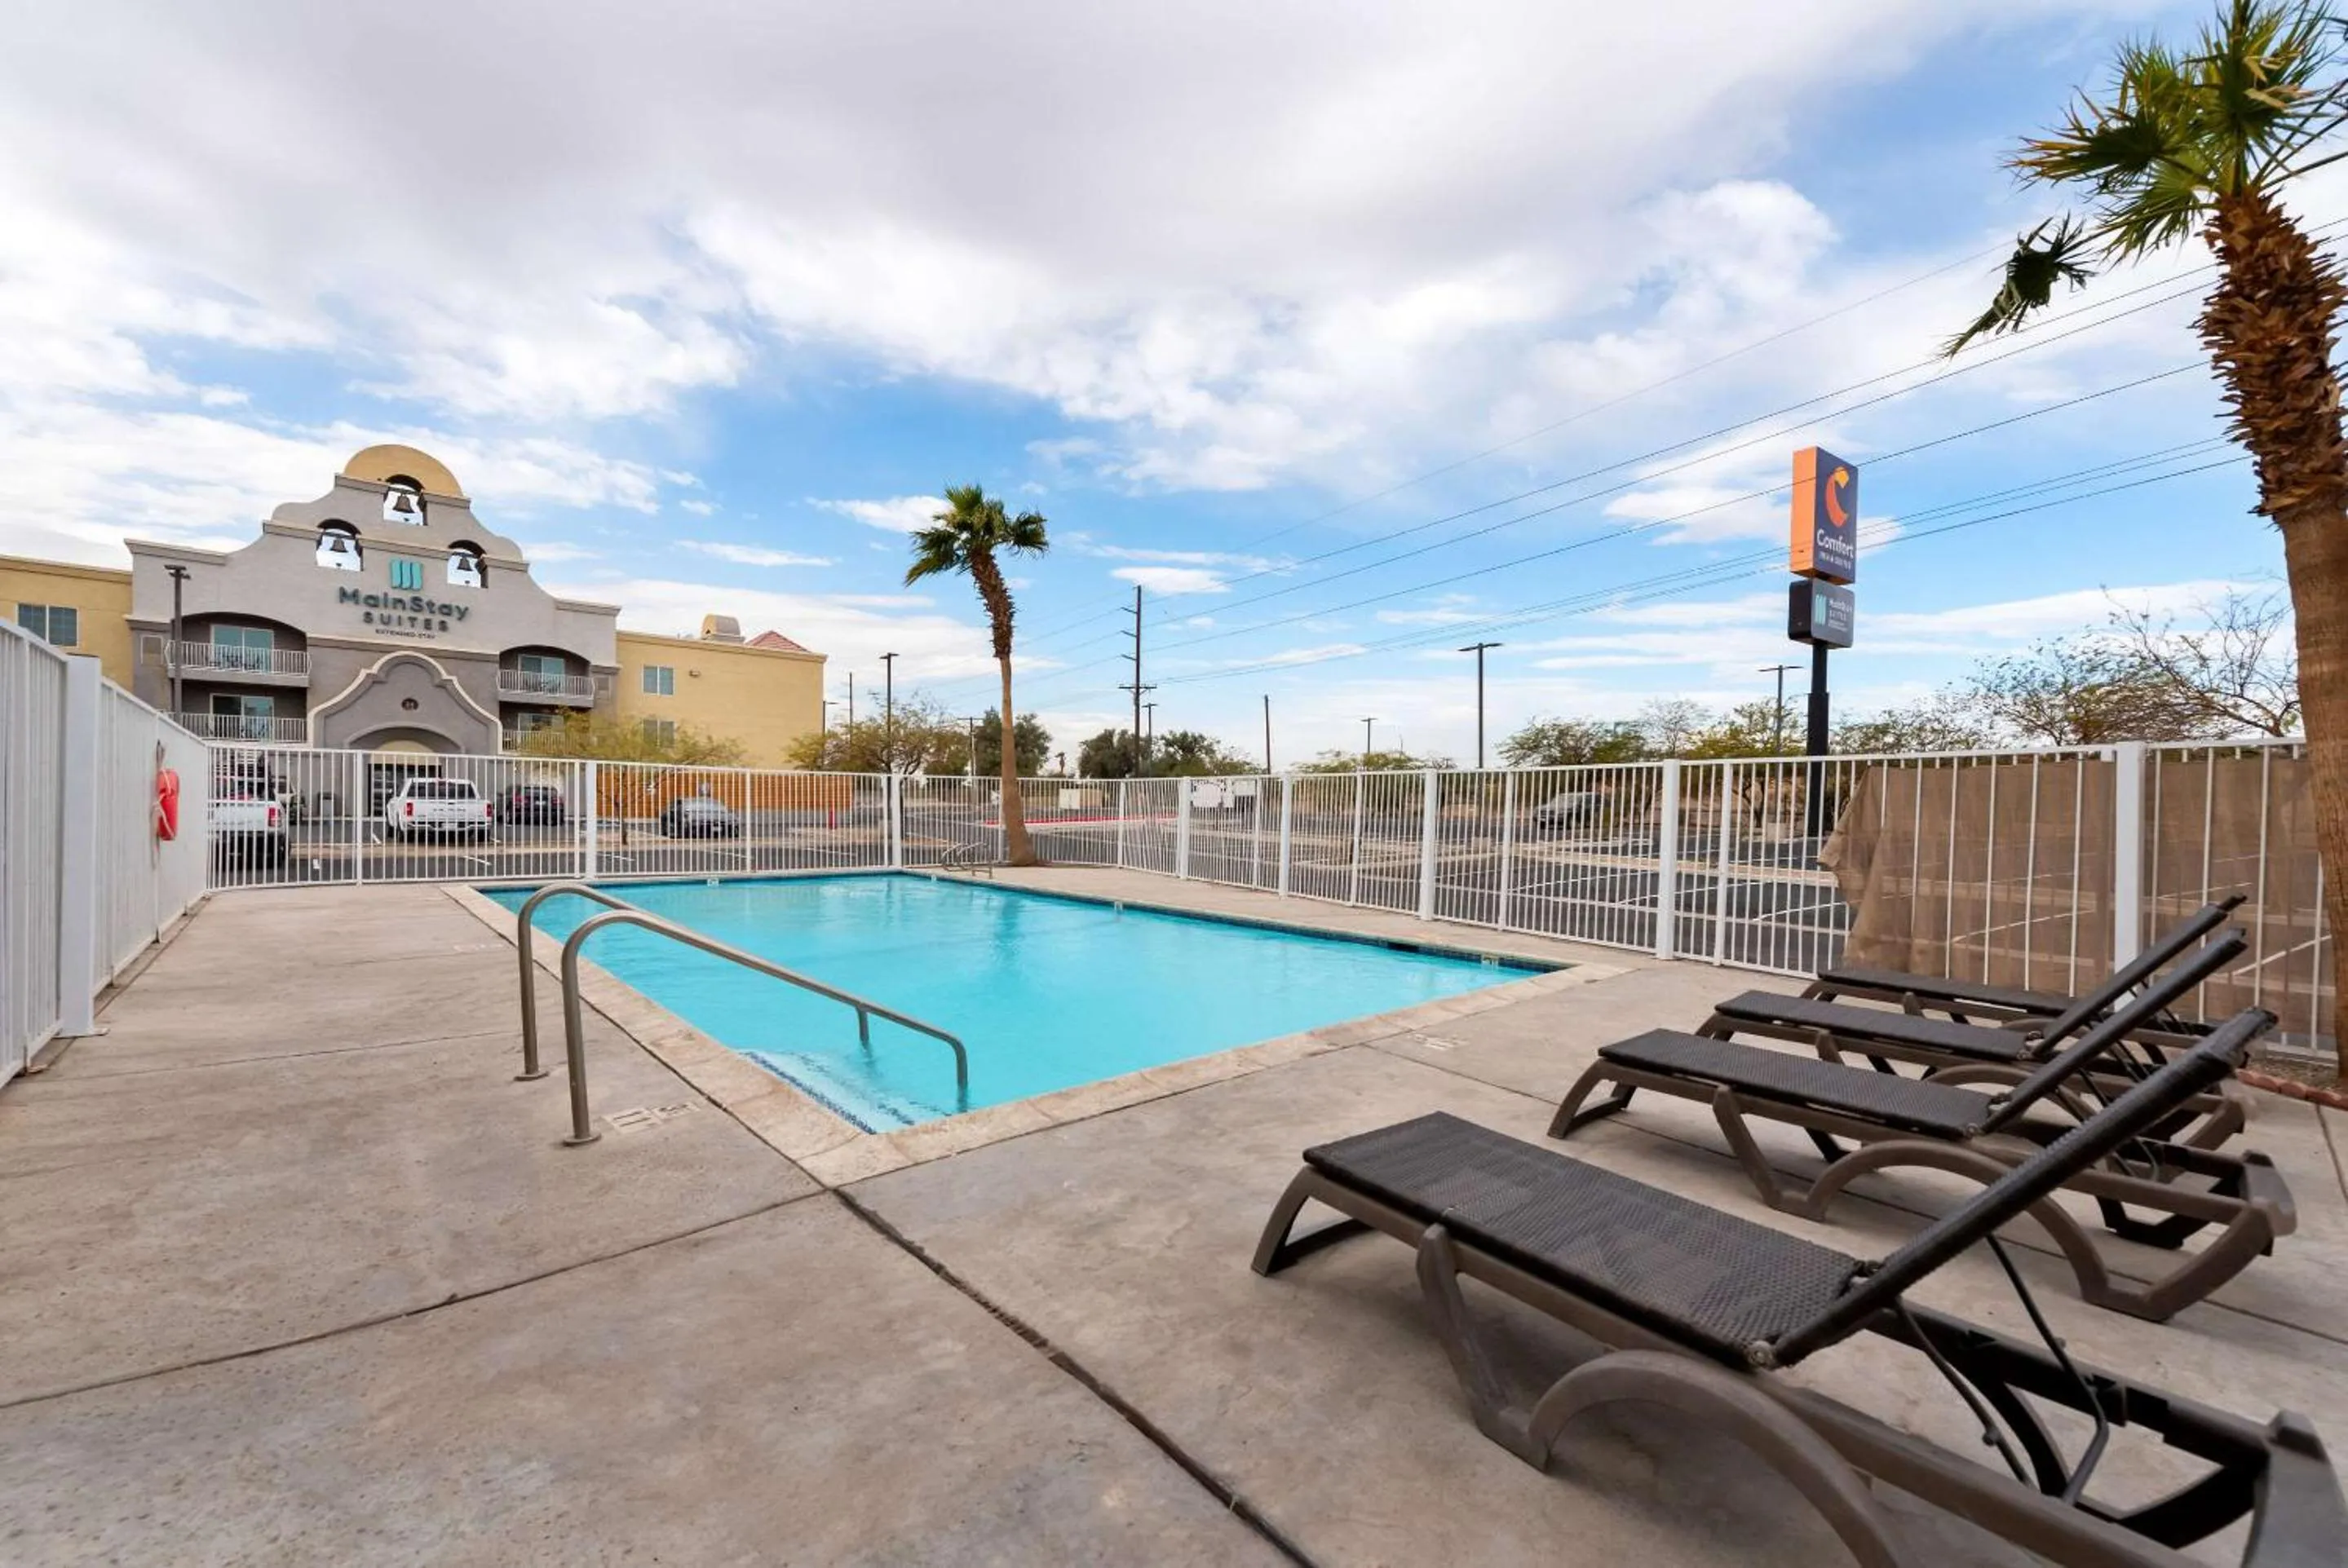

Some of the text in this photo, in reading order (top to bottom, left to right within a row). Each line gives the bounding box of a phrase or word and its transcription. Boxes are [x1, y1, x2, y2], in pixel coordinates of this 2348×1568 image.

[1817, 528, 1853, 559] Comfort
[338, 586, 469, 621] MainStay
[363, 612, 449, 632] SUITES
